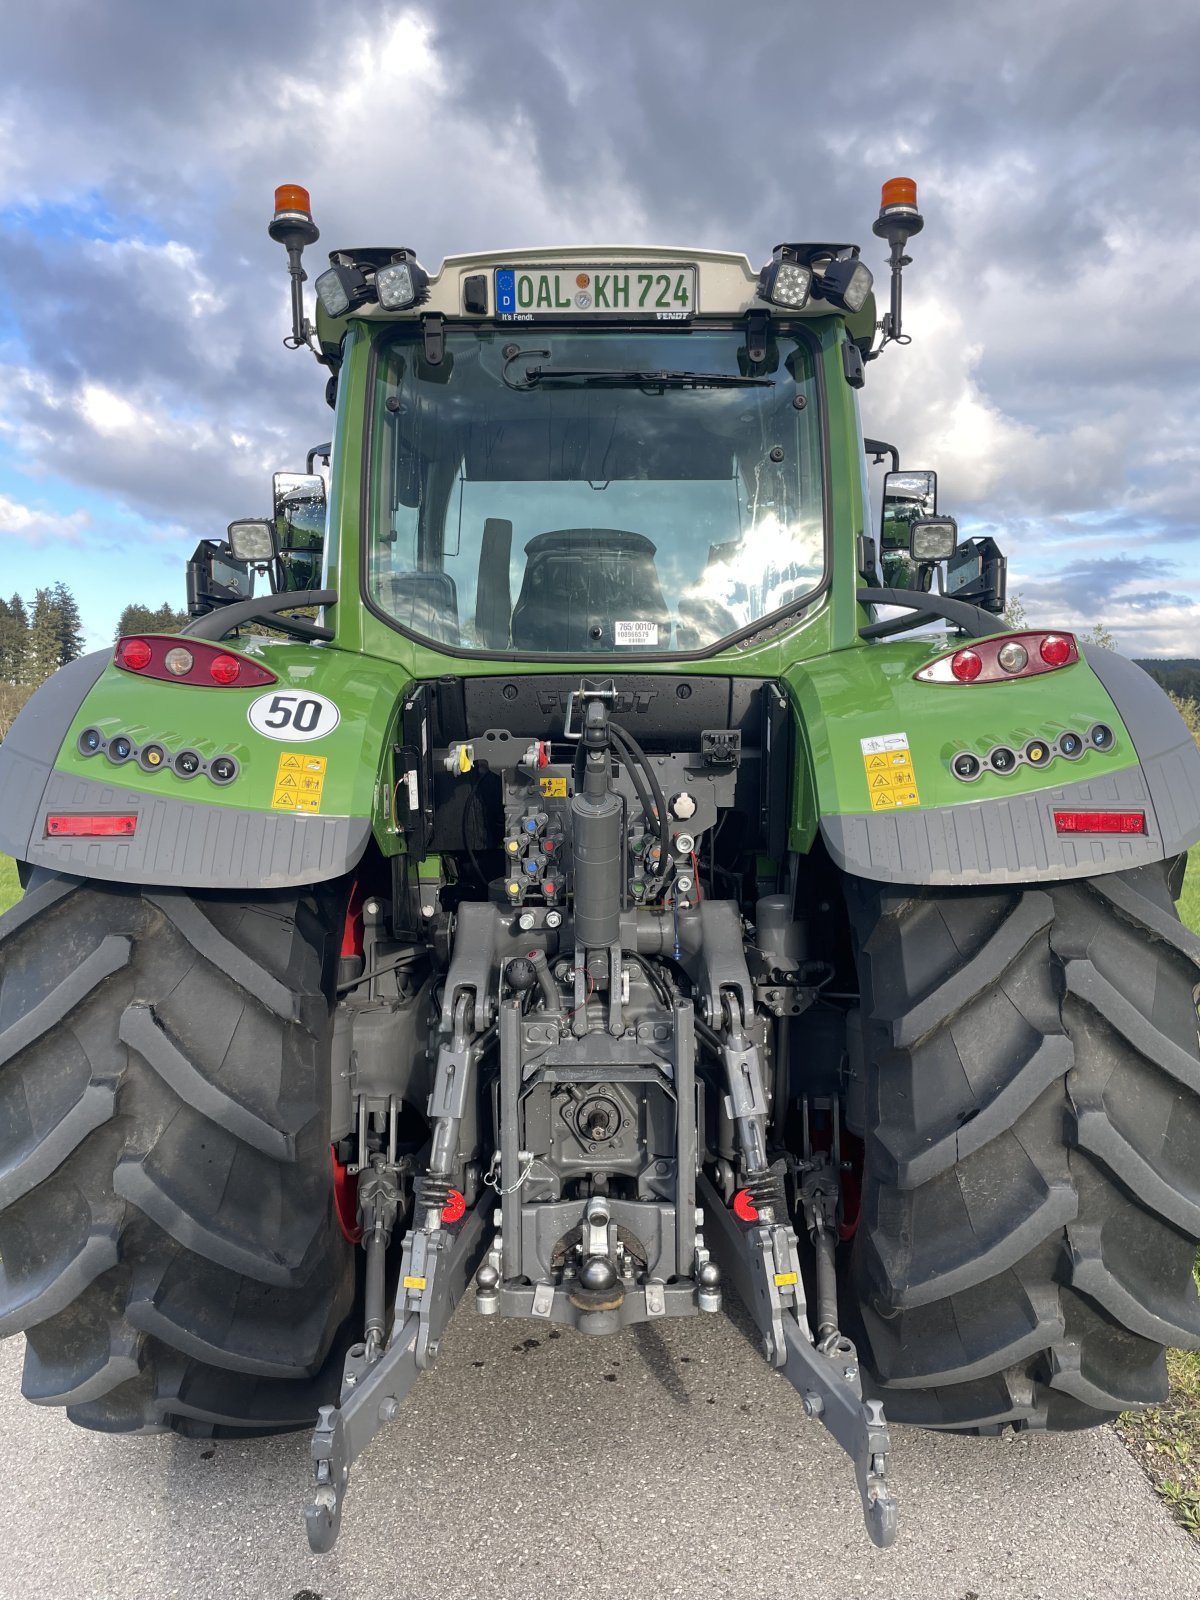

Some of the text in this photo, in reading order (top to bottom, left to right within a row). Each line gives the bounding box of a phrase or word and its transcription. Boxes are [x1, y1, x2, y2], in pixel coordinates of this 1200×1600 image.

[517, 274, 689, 308] OAL KH 724
[503, 296, 510, 306] D
[502, 313, 535, 321] It's Fendt.
[656, 312, 689, 320] FENDT
[265, 696, 323, 732] 50
